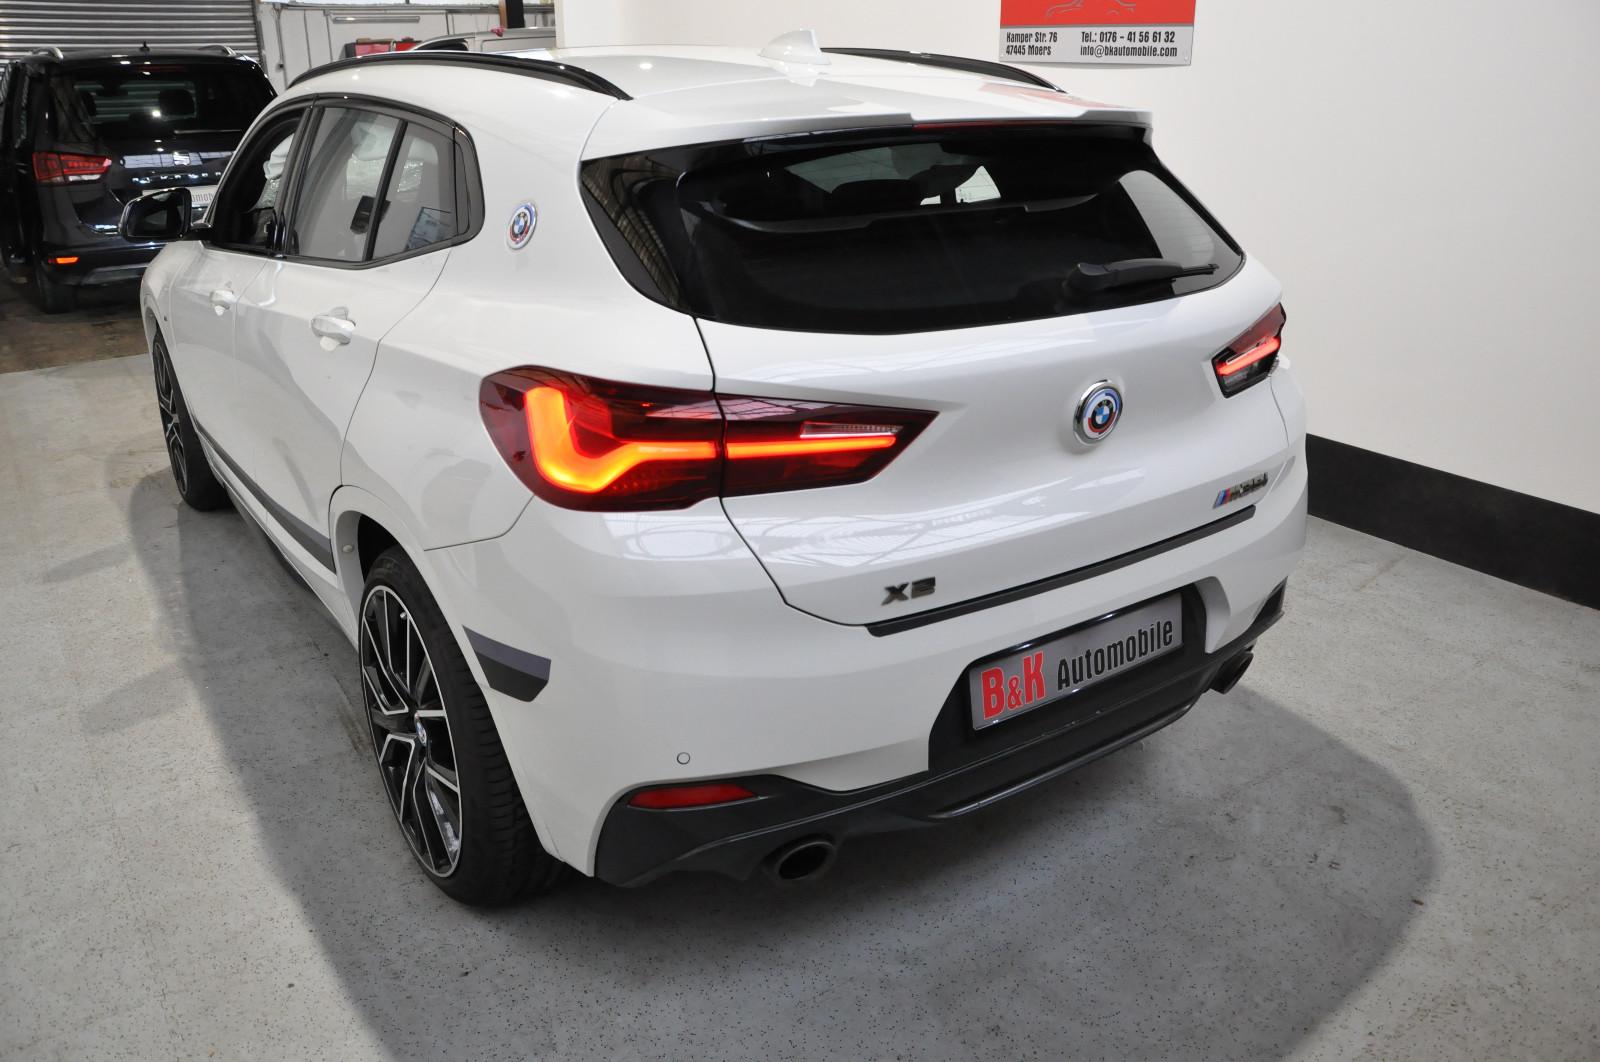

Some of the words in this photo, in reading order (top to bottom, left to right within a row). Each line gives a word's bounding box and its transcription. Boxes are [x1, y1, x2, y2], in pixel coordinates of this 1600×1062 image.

[1006, 32, 1033, 43] Kamper
[1034, 32, 1047, 43] Str.
[1049, 32, 1058, 43] 76
[1081, 31, 1097, 43] Tel.:
[1099, 31, 1117, 43] 0176
[1127, 31, 1136, 43] 41
[1138, 31, 1150, 43] 56
[1152, 31, 1162, 43] 61
[1164, 31, 1176, 43] 32
[1006, 45, 1026, 56] 47445
[1028, 45, 1052, 56] Moers
[1080, 45, 1178, 58] info@bkautomobile.com
[881, 576, 936, 606] X2
[981, 651, 1046, 720] B&K
[1057, 619, 1173, 692] Automobile
